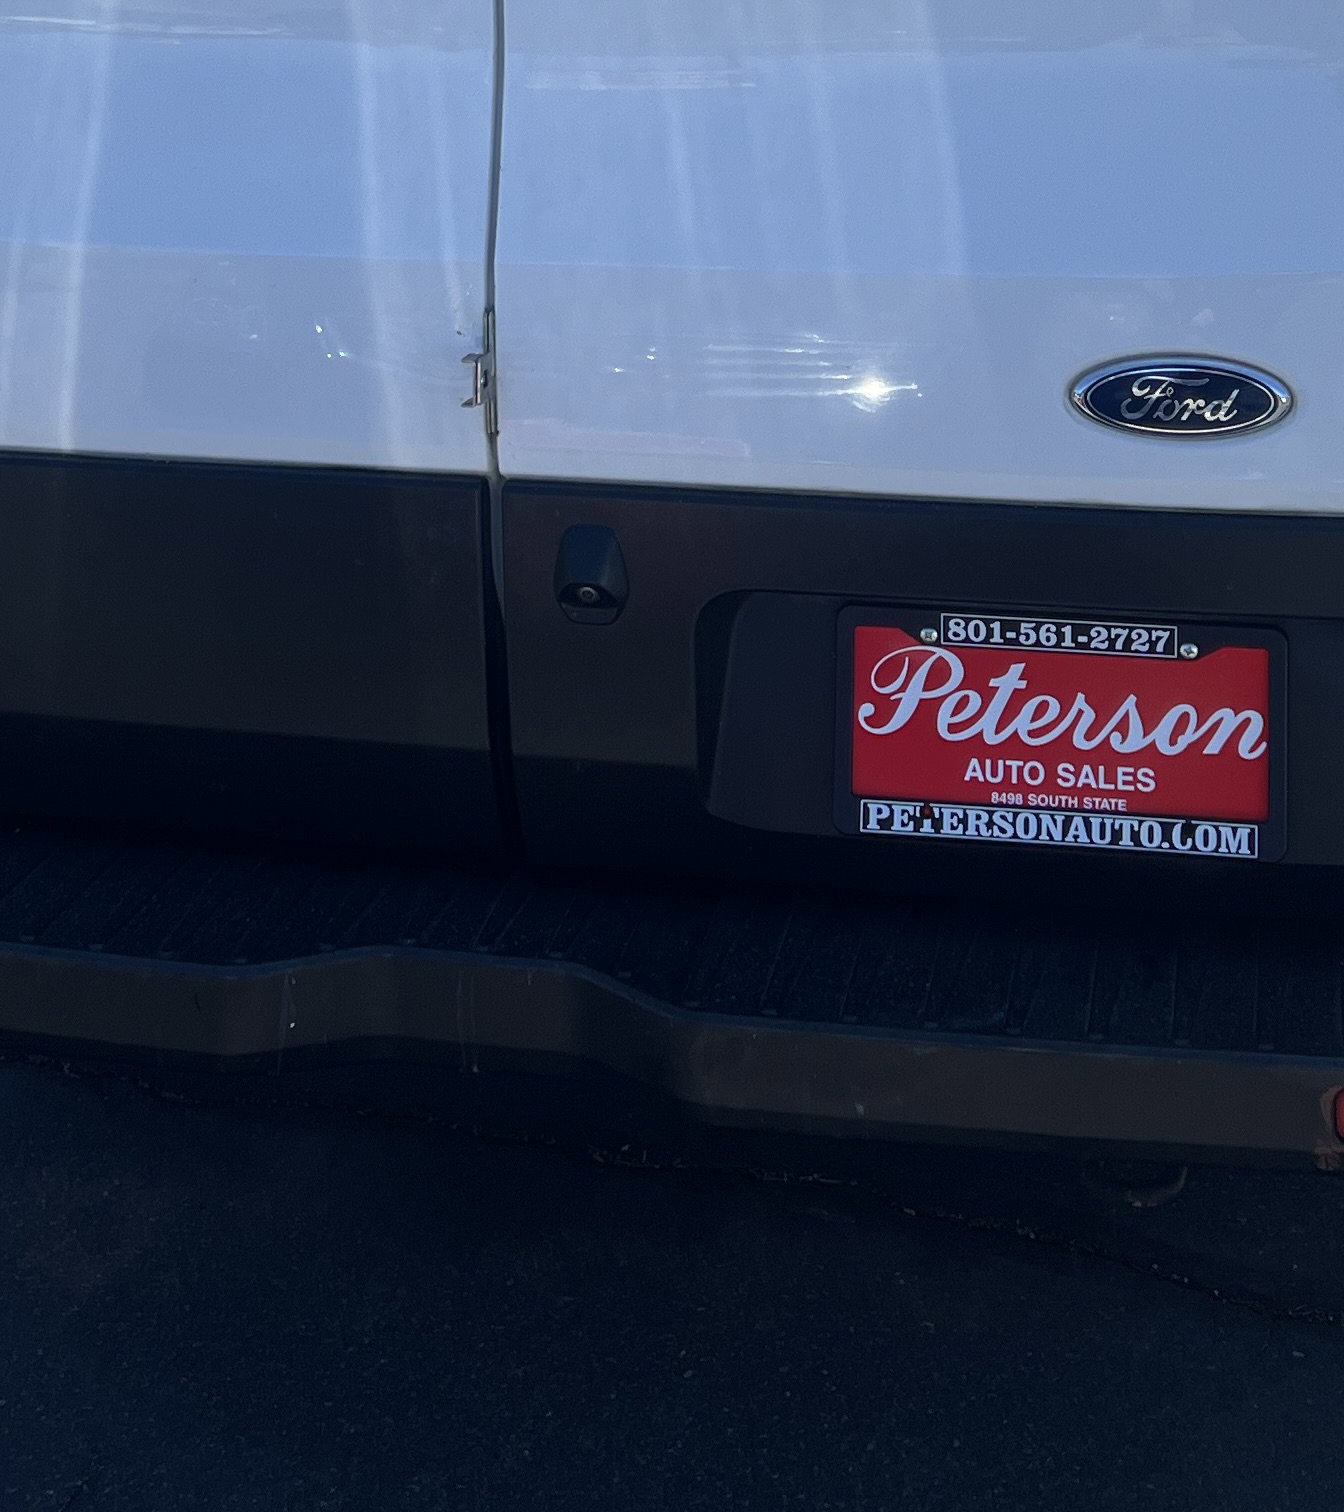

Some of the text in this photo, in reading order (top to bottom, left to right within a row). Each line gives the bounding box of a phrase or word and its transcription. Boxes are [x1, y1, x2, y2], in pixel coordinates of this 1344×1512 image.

[1119, 375, 1238, 423] Ford
[946, 618, 1170, 653] 801-561-2727
[857, 645, 1268, 760] Peterson
[963, 758, 1156, 792] AUTO SALES
[990, 792, 1127, 811] 8498 SOUTH STATE
[866, 802, 1252, 855] PETERSONAUTO.COM
